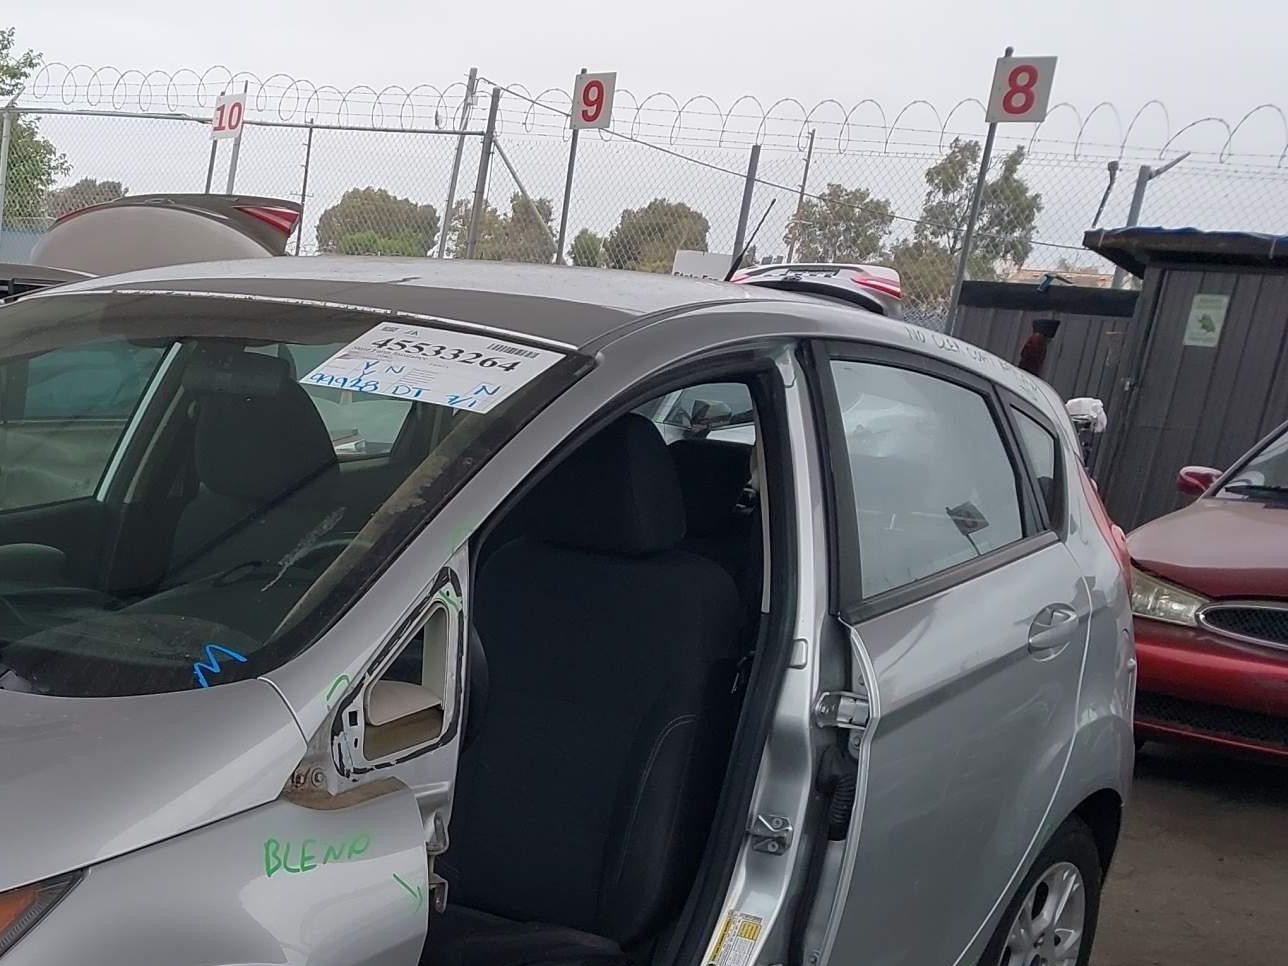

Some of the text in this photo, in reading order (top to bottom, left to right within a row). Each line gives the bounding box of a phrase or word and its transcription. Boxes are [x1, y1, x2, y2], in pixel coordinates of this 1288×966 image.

[581, 79, 605, 123] 9
[1001, 64, 1039, 115] 8
[213, 102, 243, 131] 10
[371, 337, 521, 372] 45533264
[391, 385, 433, 399] DT
[193, 644, 248, 688] M
